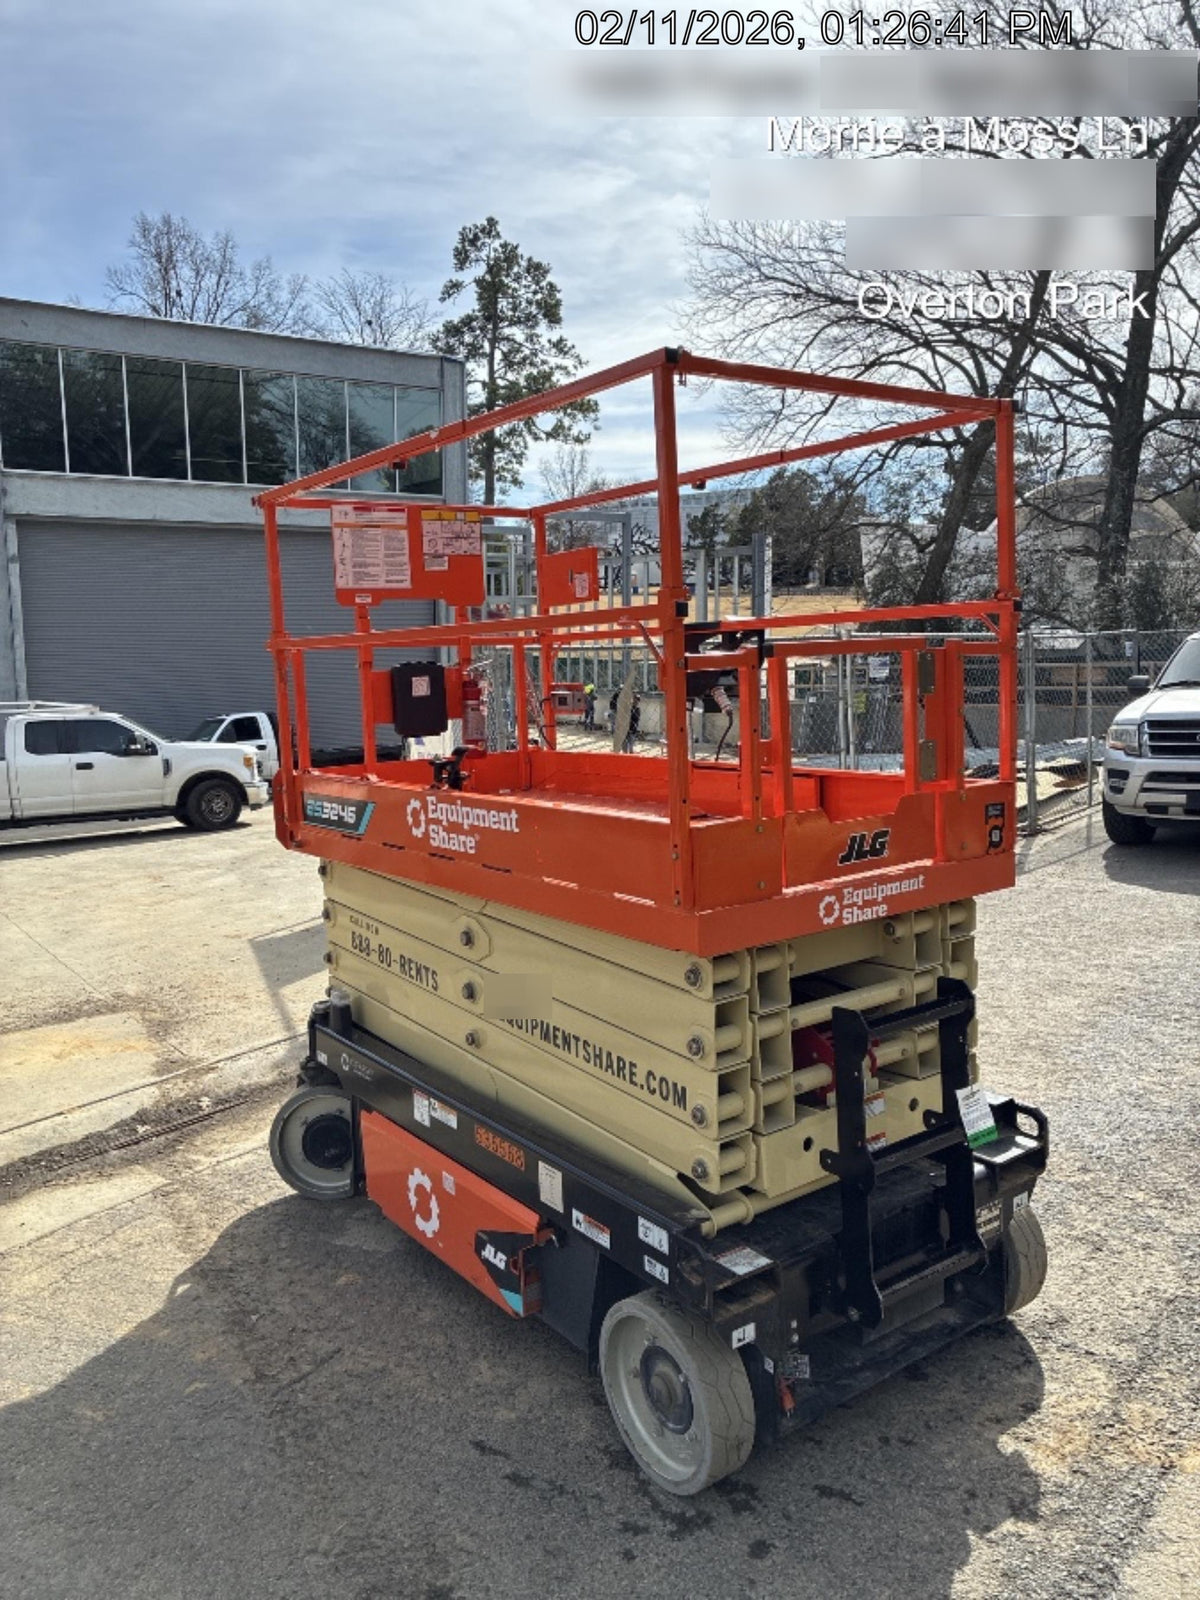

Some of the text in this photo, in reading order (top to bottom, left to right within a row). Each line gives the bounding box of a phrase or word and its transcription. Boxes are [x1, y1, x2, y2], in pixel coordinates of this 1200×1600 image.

[426, 796, 520, 833] Equipment
[428, 824, 477, 854] Share
[838, 828, 891, 867] JLG
[842, 874, 925, 906] Equipment
[842, 903, 888, 926] Share
[481, 1243, 507, 1270] JLG
